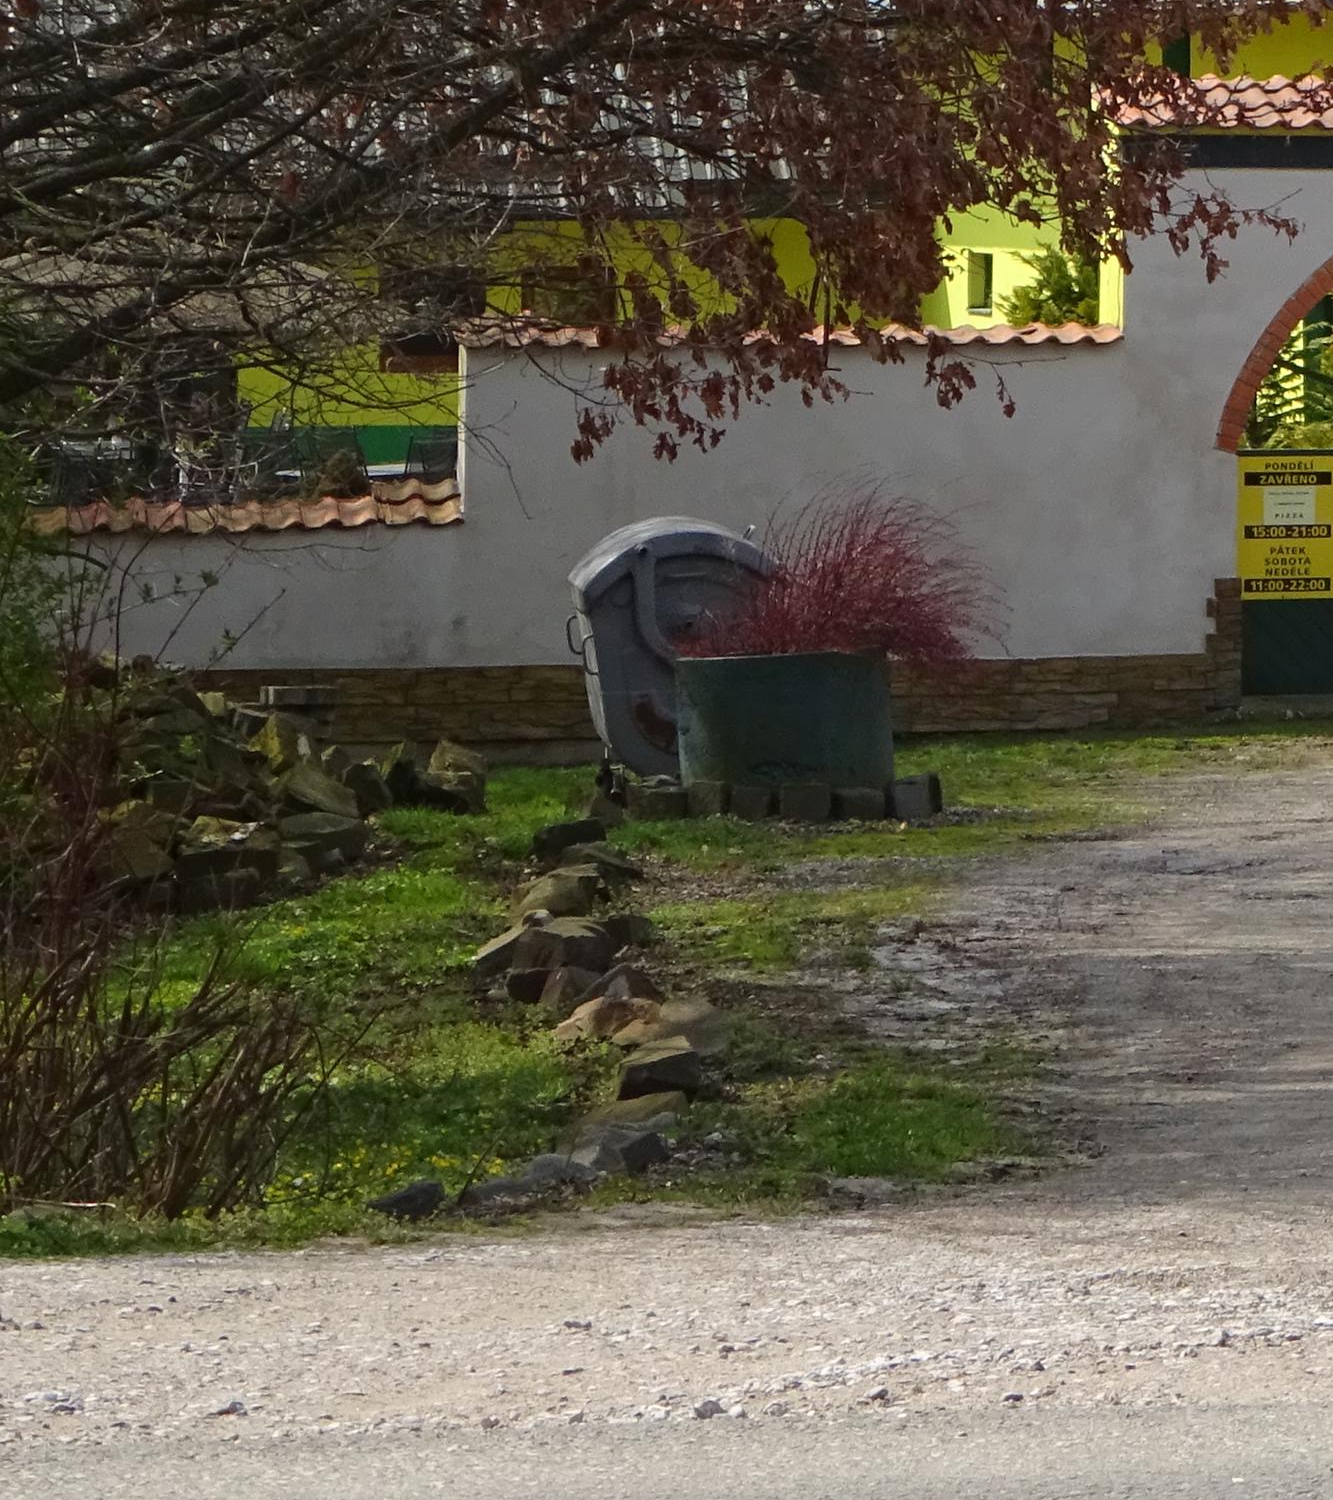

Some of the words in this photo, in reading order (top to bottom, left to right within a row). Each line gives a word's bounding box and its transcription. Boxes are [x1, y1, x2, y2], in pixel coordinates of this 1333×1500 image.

[1260, 474, 1317, 484] ZAVŘENO
[1252, 526, 1328, 537] 15:00-21:00
[1264, 556, 1311, 566] SOBOTA
[1251, 580, 1325, 591] 11:00-22:00
